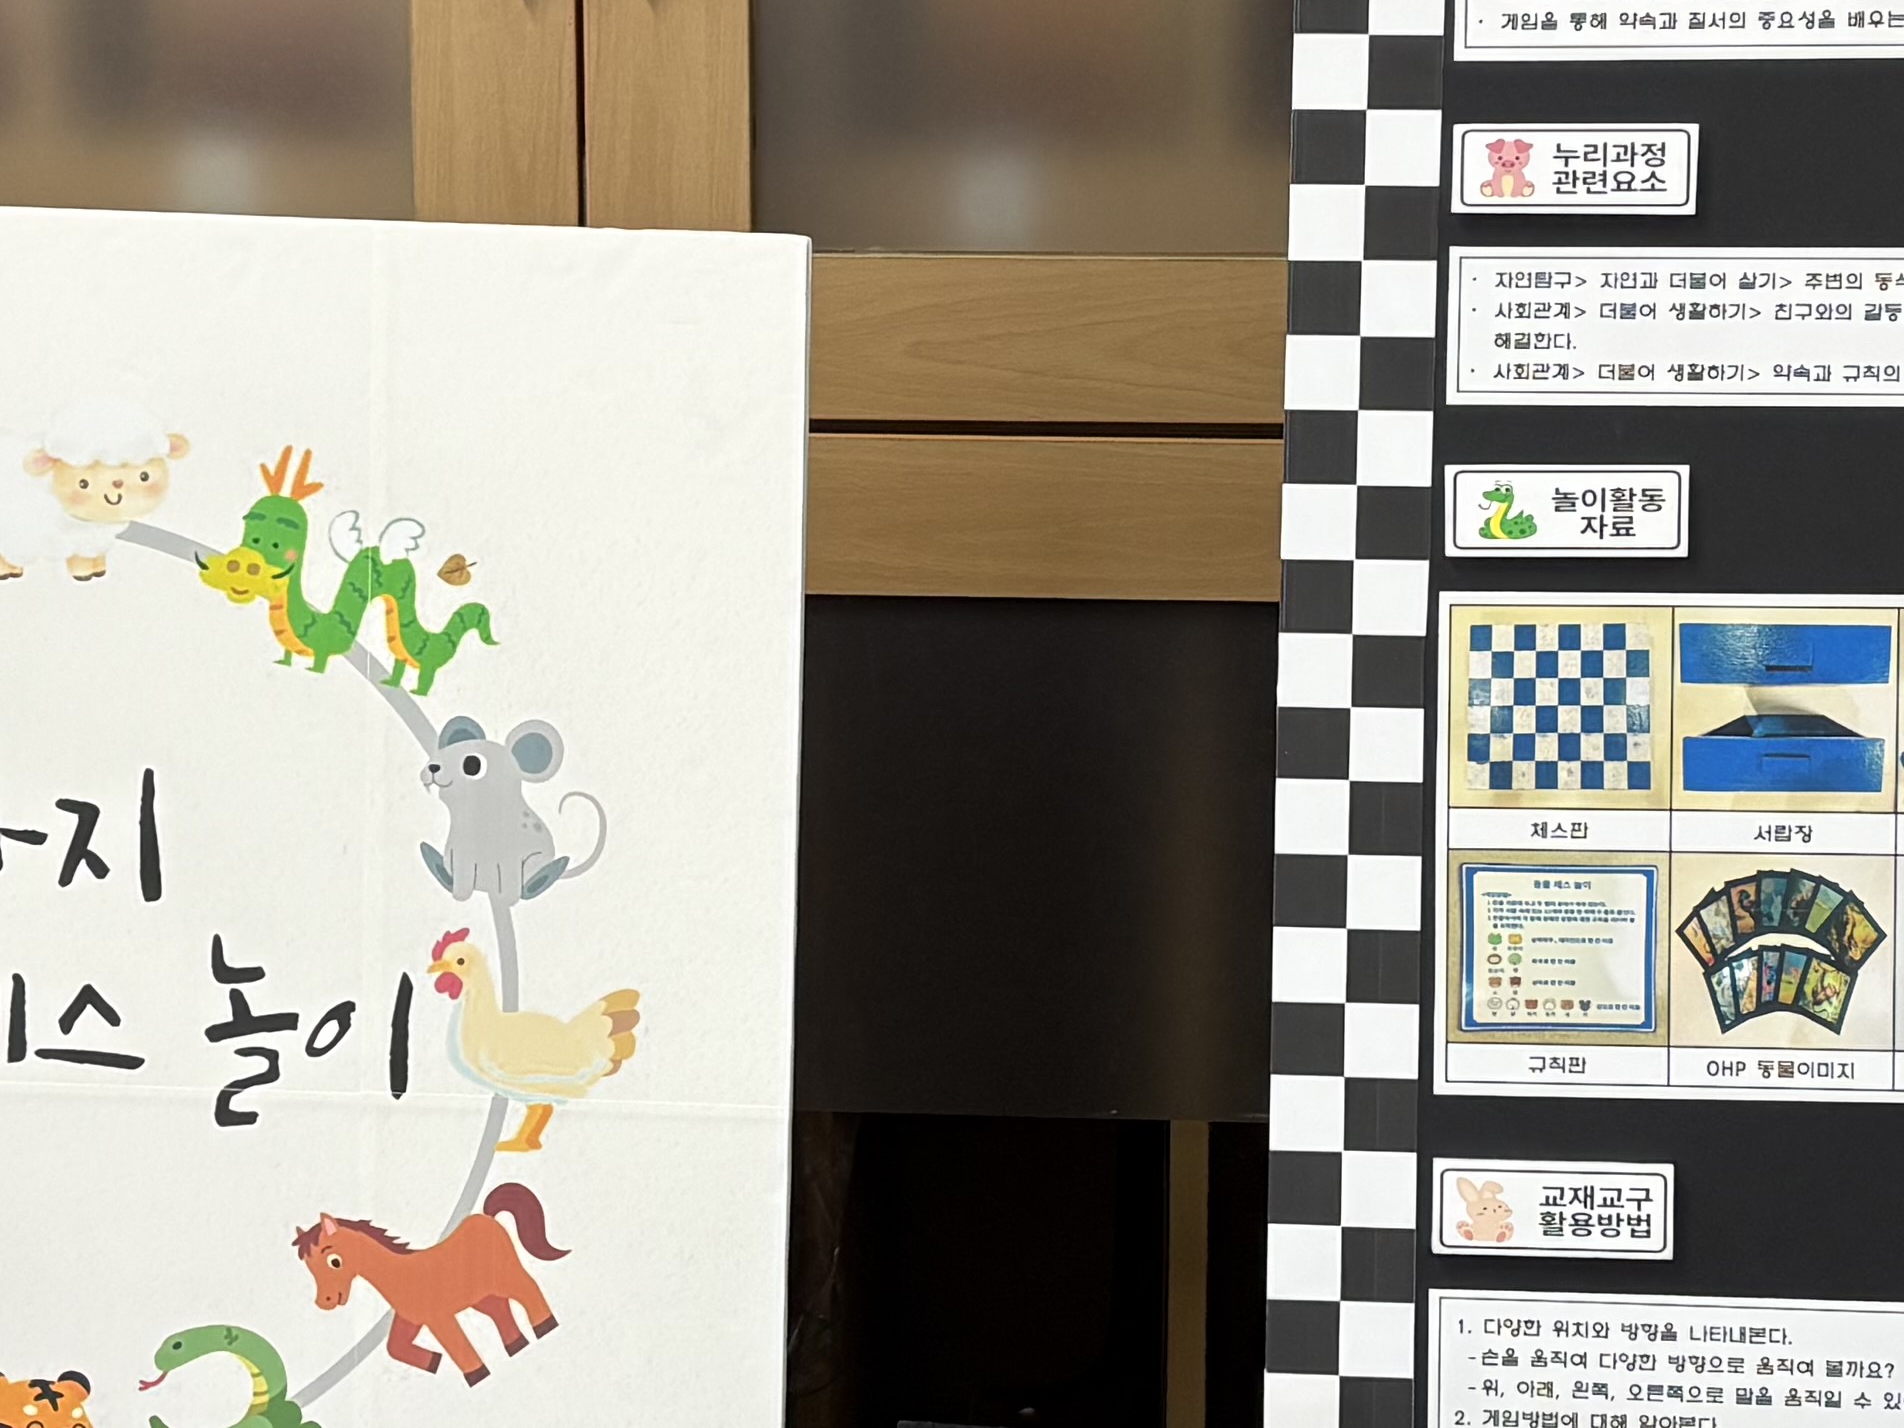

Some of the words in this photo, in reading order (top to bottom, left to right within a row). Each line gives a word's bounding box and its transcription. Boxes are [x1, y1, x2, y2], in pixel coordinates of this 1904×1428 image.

[1501, 11, 1558, 31] 게임을
[1569, 12, 1608, 32] 통해
[1619, 11, 1678, 30] 약속과
[1688, 11, 1746, 30] 질서의
[1758, 9, 1836, 31] 중요성을
[1552, 141, 1666, 168] 누리과정
[1552, 169, 1668, 195] 관련요소
[1495, 271, 1587, 290] 자연탐구>
[1600, 271, 1659, 290] 자연과
[1669, 272, 1727, 290] 더불어
[1738, 271, 1793, 290] 살기>
[1804, 272, 1863, 291] 주변의
[1494, 301, 1587, 320] 사회관계>
[1599, 302, 1657, 320] 더불어
[1668, 301, 1762, 321] 생활하기>
[1774, 302, 1852, 321] 친구와의
[1493, 332, 1577, 351] 해결한다.
[1493, 362, 1585, 381] 사회관계>
[1598, 363, 1655, 381] 더불어
[1666, 362, 1760, 383] 생활하기>
[1773, 363, 1832, 383] 약속과
[1842, 364, 1900, 383] 규칙의
[1551, 487, 1666, 513] 놀이활동
[1580, 514, 1636, 540] 자료
[1530, 821, 1589, 840] 체스판
[1753, 824, 1813, 844] 서랍장
[204, 932, 414, 1126] 놀이
[1528, 1056, 1587, 1075] 규칙판
[1706, 1060, 1747, 1077] OHP
[1757, 1060, 1855, 1080] 동물이미지
[1538, 1185, 1654, 1213] 교재교구
[1538, 1210, 1652, 1239] 활용방법
[1458, 1318, 1472, 1335] 1.
[1483, 1318, 1542, 1338] 다양한
[1552, 1319, 1610, 1340] 위치와
[1620, 1322, 1678, 1342] 방향을
[1689, 1325, 1793, 1346] 나타내본다.
[1530, 1348, 1588, 1370] 움직여
[1599, 1352, 1657, 1372] 다양한
[1668, 1355, 1745, 1374] 방향으로
[1756, 1356, 1814, 1377] 움직여
[1825, 1359, 1895, 1379] 볼까요?
[1516, 1380, 1560, 1400] 아래,
[1571, 1380, 1615, 1402] 왼쪽,
[1626, 1383, 1724, 1404] 오른쪽으로
[1735, 1386, 1773, 1406] 말을
[1784, 1387, 1842, 1409] 움직일
[1853, 1391, 1872, 1410] 수
[1454, 1409, 1471, 1426] 2.
